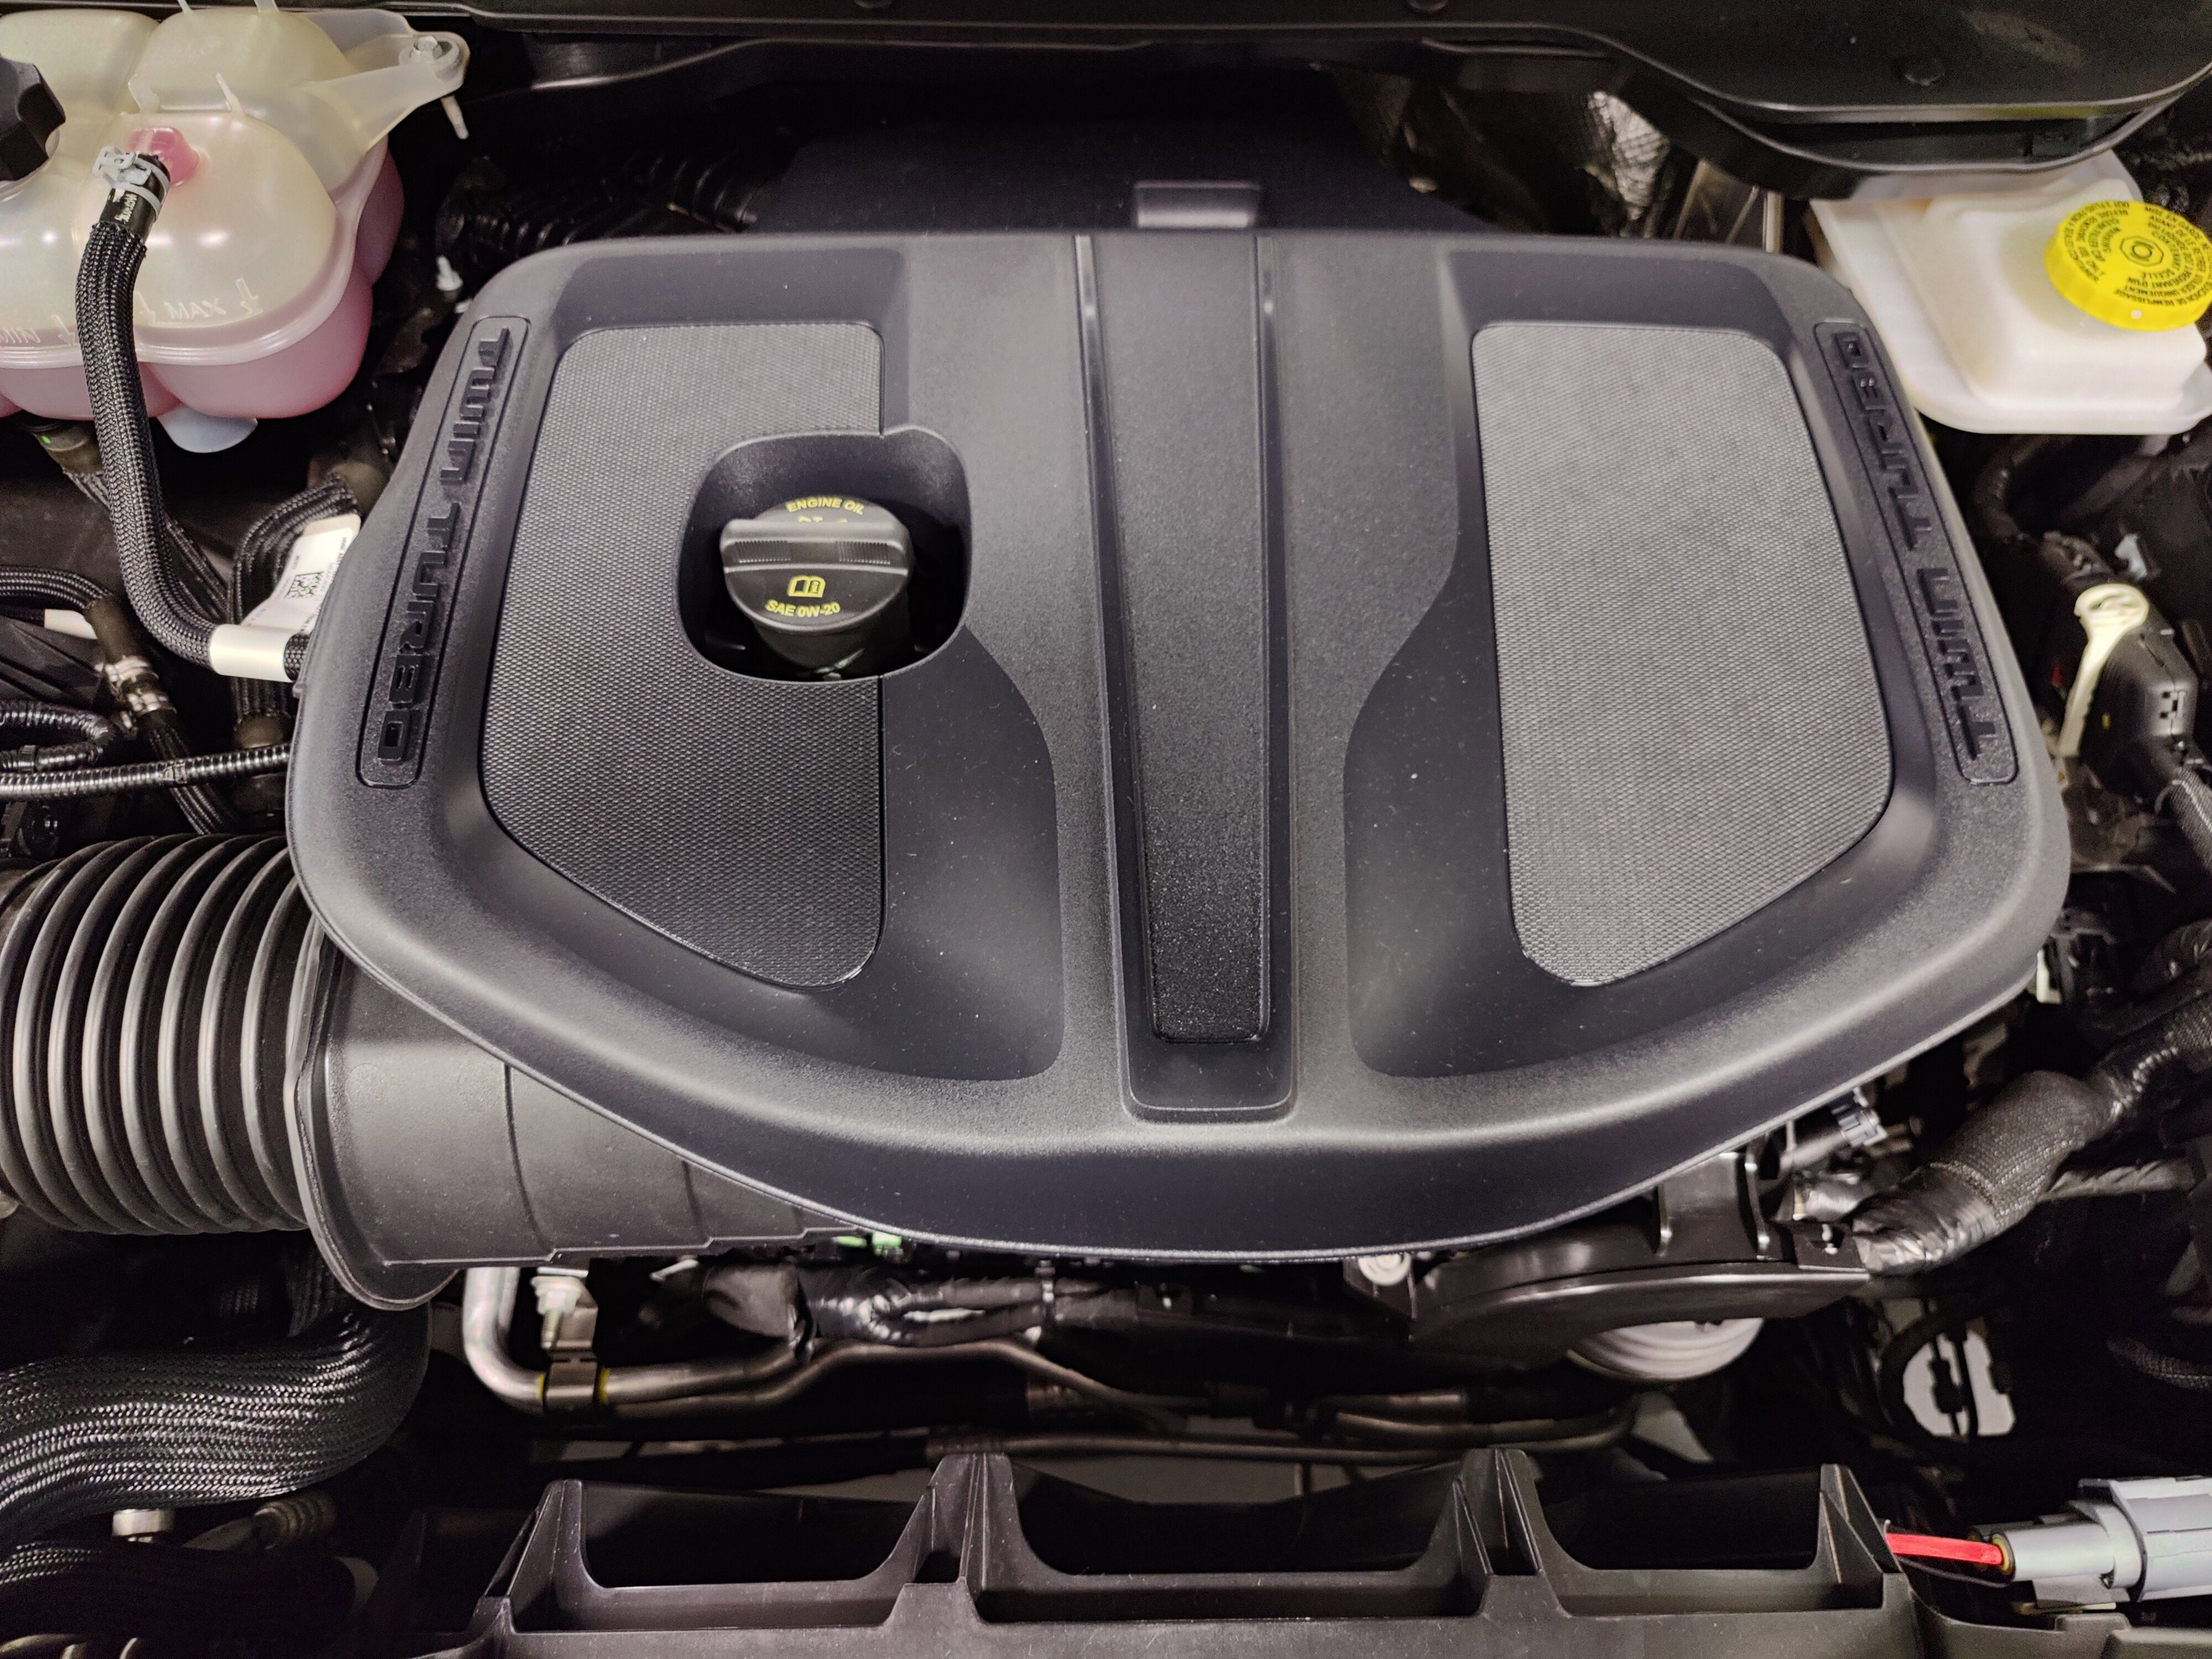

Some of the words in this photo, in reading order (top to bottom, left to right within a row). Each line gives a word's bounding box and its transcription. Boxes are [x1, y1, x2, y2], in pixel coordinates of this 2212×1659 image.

[164, 298, 227, 320] MAX
[440, 327, 512, 484] TWIN
[1832, 331, 1933, 552] TURBO
[785, 497, 842, 513] ENGINE
[843, 498, 864, 516] OIL
[377, 501, 462, 763] TURBO
[765, 598, 795, 618] SAE
[797, 601, 841, 618] 0W-20
[1916, 566, 1996, 762] TWIN
